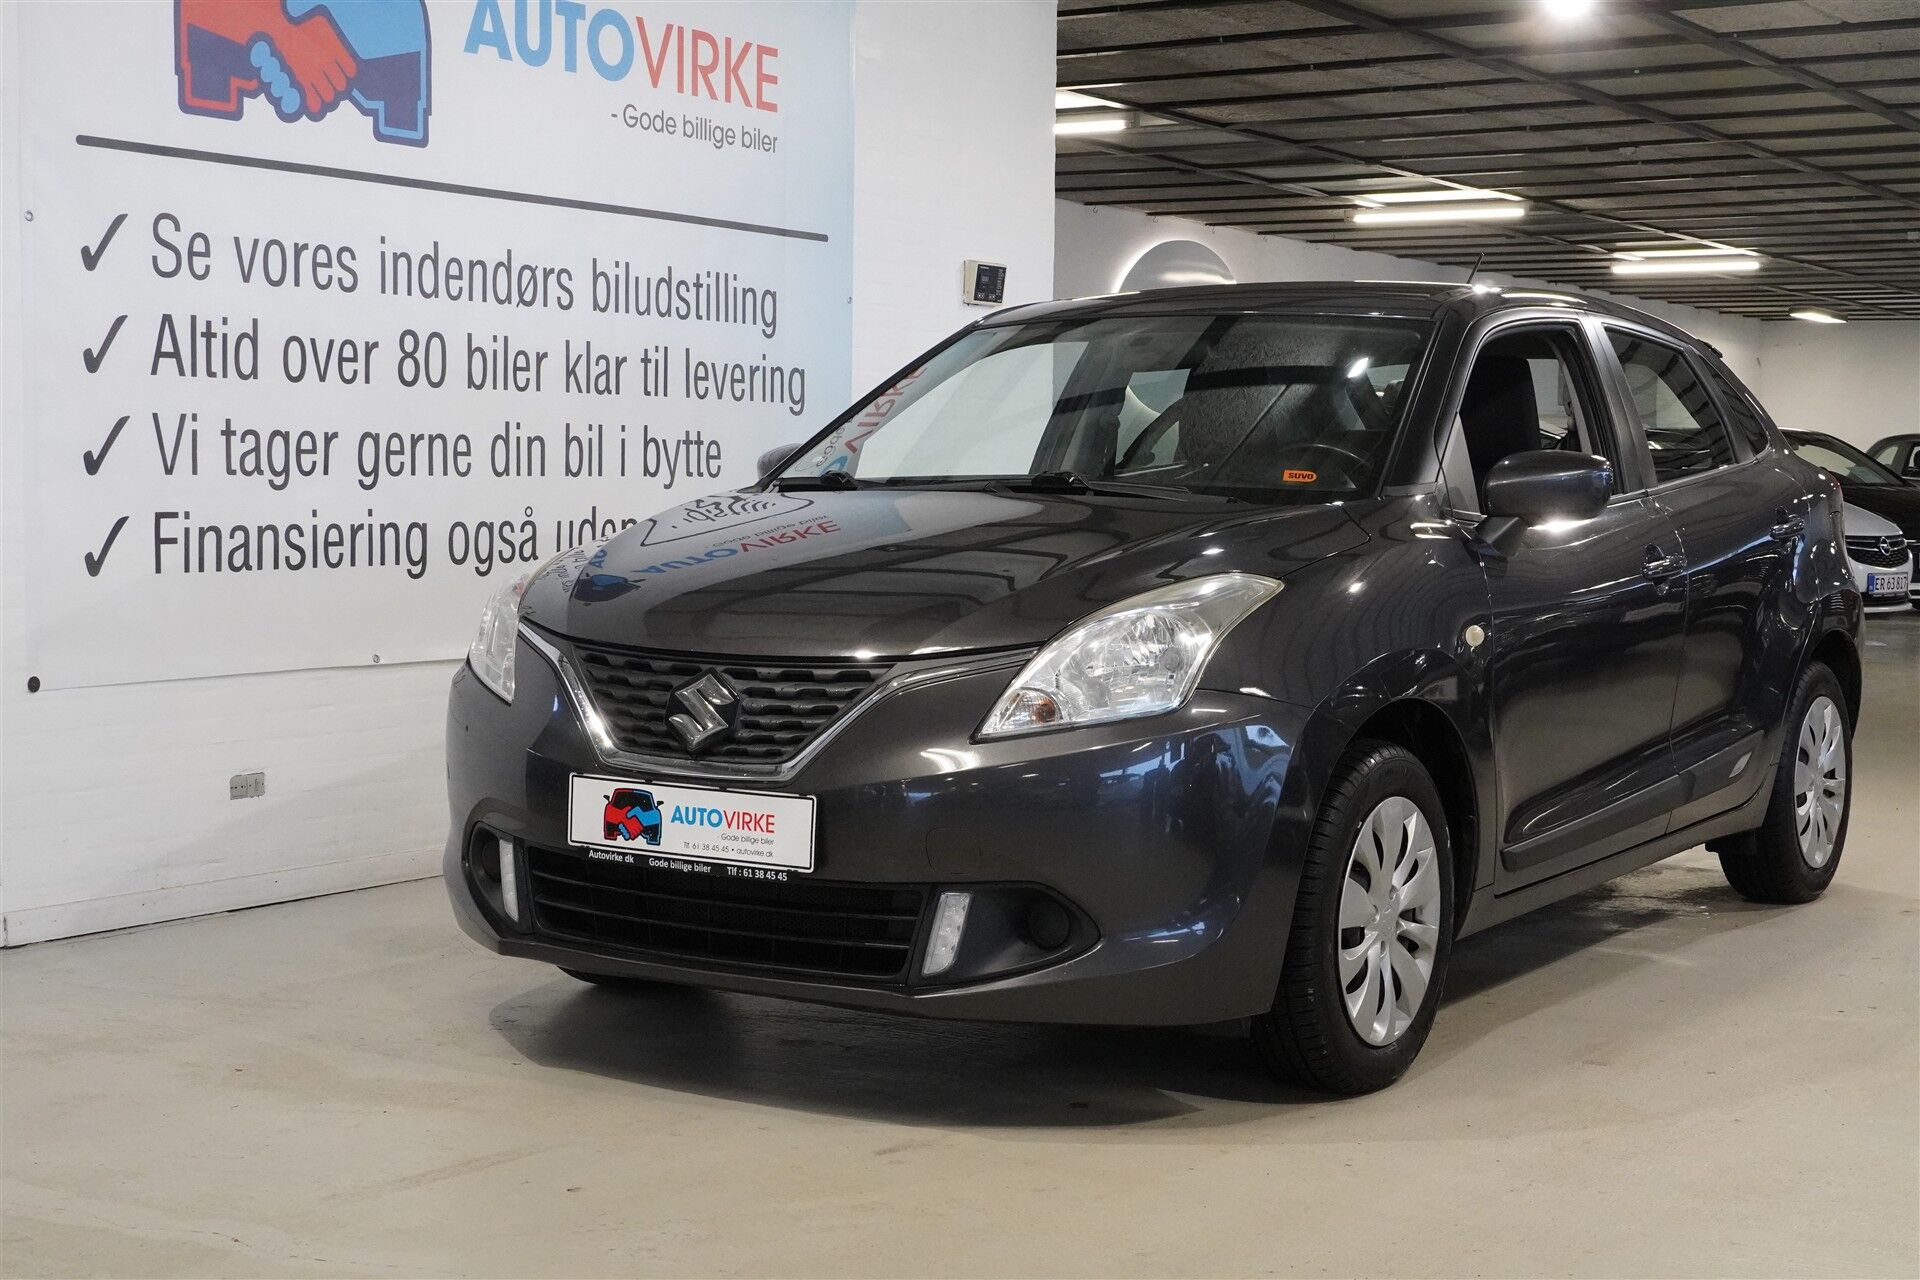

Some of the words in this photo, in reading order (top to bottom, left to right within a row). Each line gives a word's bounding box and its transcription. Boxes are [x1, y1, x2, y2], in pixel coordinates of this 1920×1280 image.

[463, 0, 778, 113] AUTOVIRKE
[623, 103, 677, 135] Gode
[682, 115, 736, 150] billige
[741, 126, 778, 153] biler
[151, 212, 211, 281] Se
[233, 237, 359, 293] vores
[380, 236, 574, 311] indendørs
[592, 257, 777, 340] biludstilling
[150, 313, 259, 381] Altid
[282, 336, 379, 385] over
[397, 328, 447, 389] 80
[467, 332, 549, 393] biler
[565, 339, 628, 397] klar
[640, 346, 670, 399] til
[685, 347, 806, 417] levering
[152, 412, 198, 476] Vi
[220, 418, 339, 491] tager
[357, 431, 472, 491] gerne
[490, 421, 546, 478] din
[564, 422, 603, 478] bil
[620, 424, 626, 477] i
[643, 424, 722, 490] bytte
[1287, 472, 1314, 480] SUVO
[154, 509, 428, 580] Finansiering
[448, 506, 539, 578] også
[1875, 577, 1886, 591] ER
[670, 805, 776, 834] AUTOVIRKE
[720, 832, 740, 842] Gode
[740, 835, 760, 846] billige
[760, 837, 775, 846] biler
[588, 849, 623, 862] Autovirke
[648, 857, 669, 868] Gode
[669, 860, 693, 872] billige
[693, 863, 711, 873] biler
[743, 868, 753, 878] 61
[754, 869, 764, 879] 38
[766, 870, 776, 880] 45
[777, 872, 788, 882] 45
[691, 842, 700, 850] 61
[702, 843, 710, 851] 38
[711, 844, 720, 853] 45
[720, 845, 730, 854] 45
